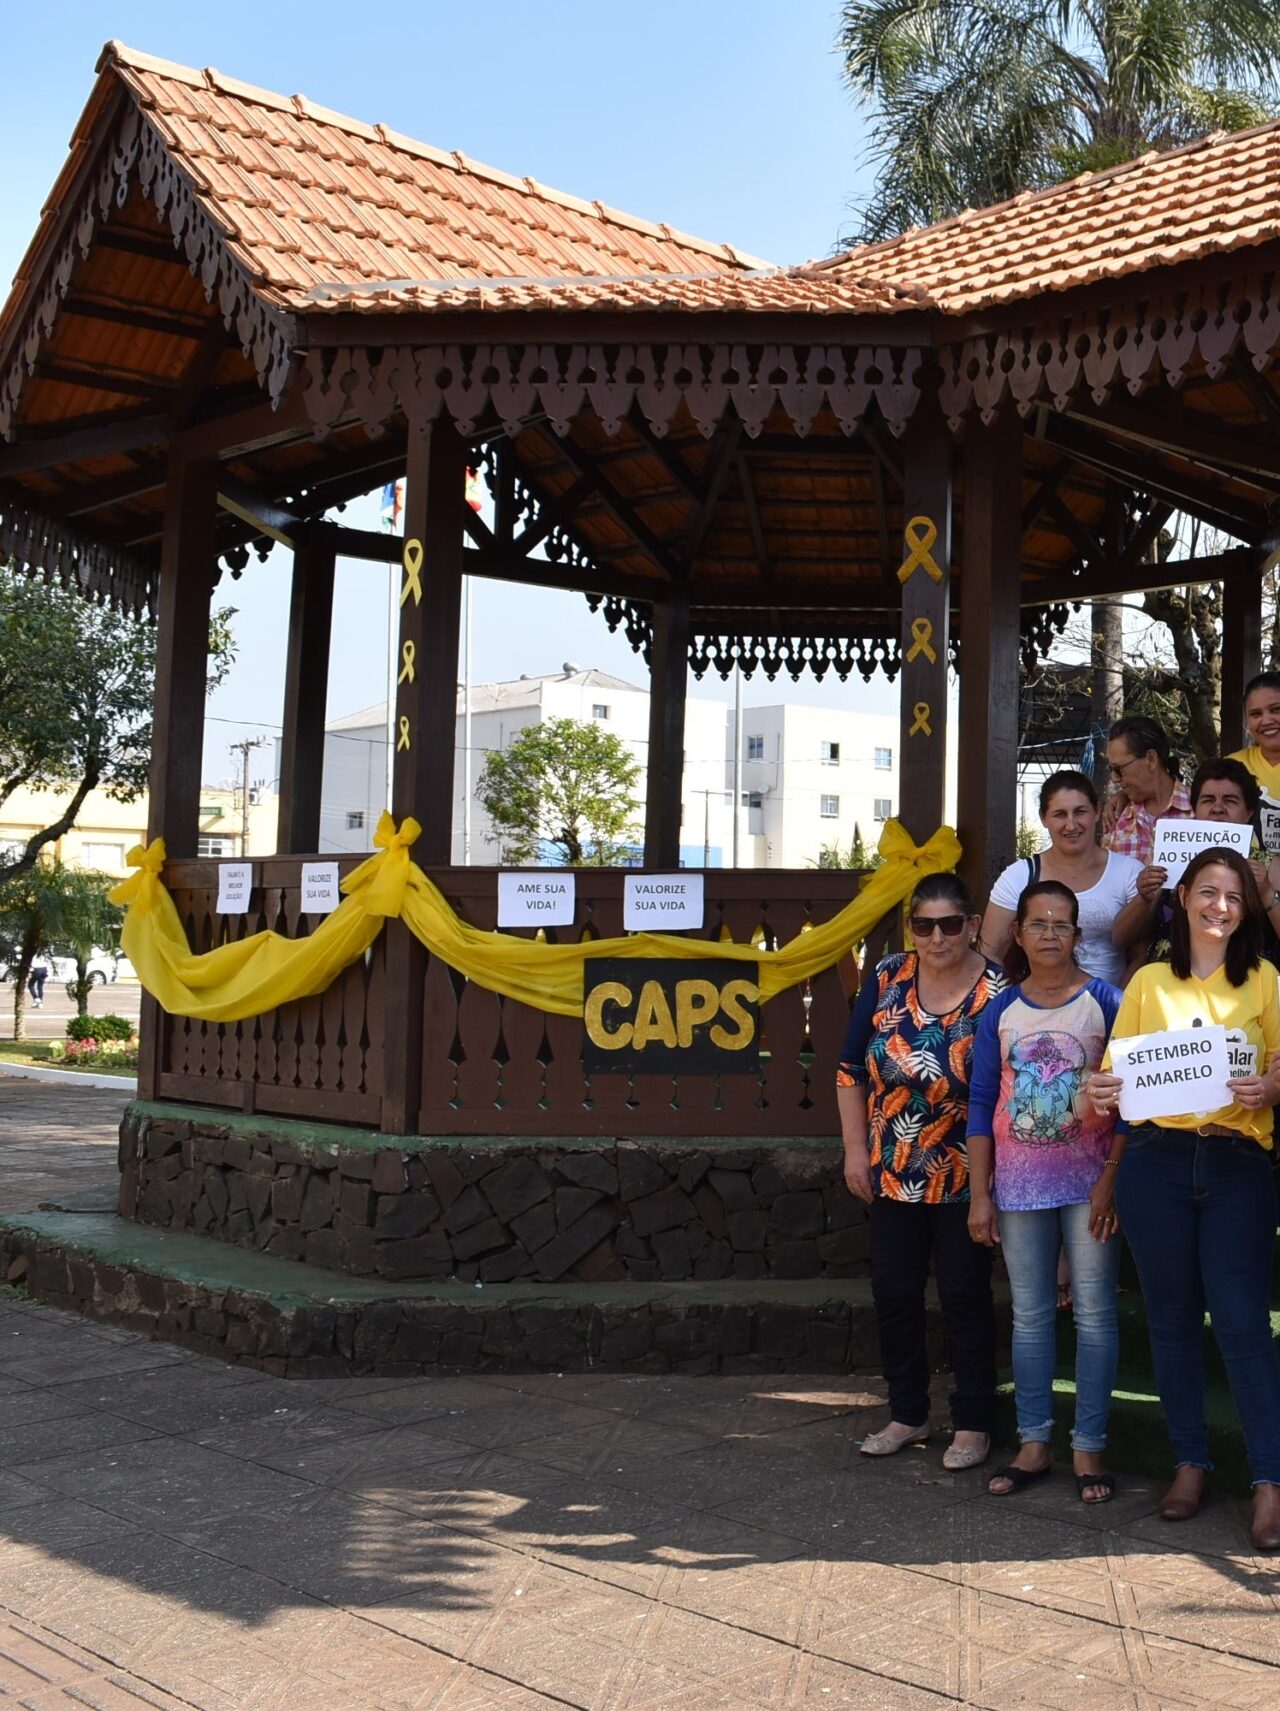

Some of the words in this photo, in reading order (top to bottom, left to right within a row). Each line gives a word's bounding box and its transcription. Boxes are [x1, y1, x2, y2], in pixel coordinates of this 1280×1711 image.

[1163, 830, 1241, 845] PREVENÇÃO
[1158, 852, 1177, 863] AO
[307, 873, 332, 883] VALORIZE
[306, 890, 317, 898] SUA
[318, 889, 331, 898] VIDA
[517, 884, 542, 893] AME
[544, 884, 566, 894] SUA
[635, 884, 686, 894] VALORIZE
[526, 900, 556, 910] VIDA!
[635, 901, 657, 910] SUA
[659, 900, 686, 910] VIDA
[584, 979, 761, 1050] CAPS
[1128, 1039, 1212, 1066] SETEMBRO
[1227, 1048, 1254, 1065] alar
[1135, 1064, 1213, 1089] AMARELO
[1230, 1068, 1252, 1078] elhor
